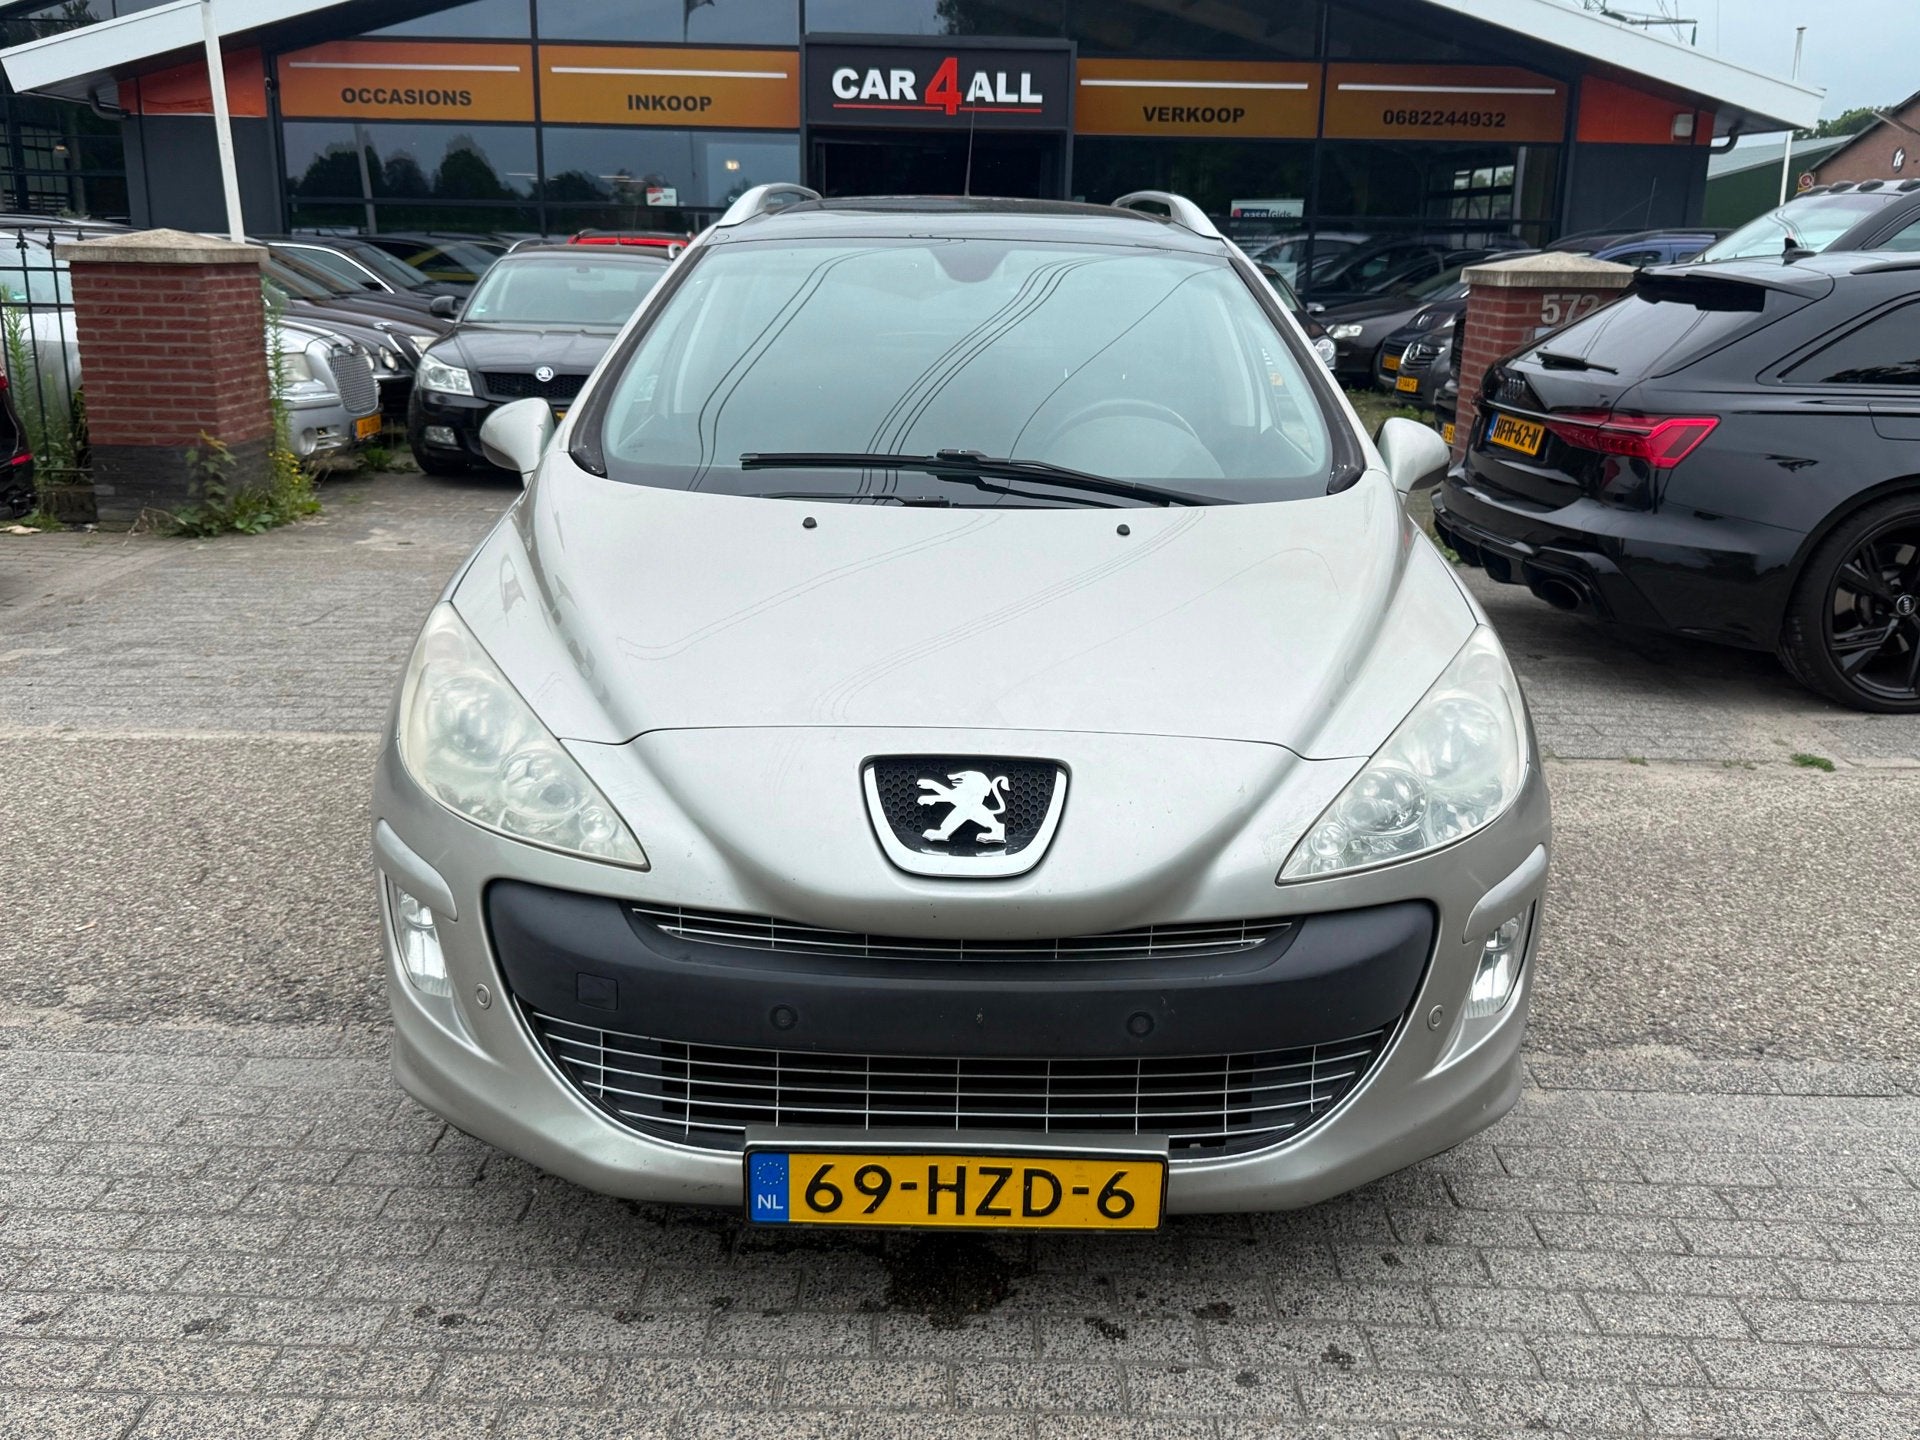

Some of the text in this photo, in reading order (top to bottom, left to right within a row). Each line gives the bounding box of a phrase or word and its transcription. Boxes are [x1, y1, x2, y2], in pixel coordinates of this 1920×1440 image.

[341, 87, 472, 106] OCCASIONS
[627, 94, 712, 112] INKOOP
[1142, 106, 1245, 123] VERKOOP
[1383, 109, 1506, 128] 0682244932
[1541, 294, 1600, 325] 572
[804, 1163, 1136, 1219] 69-HZD-6
[758, 1194, 784, 1210] NL
